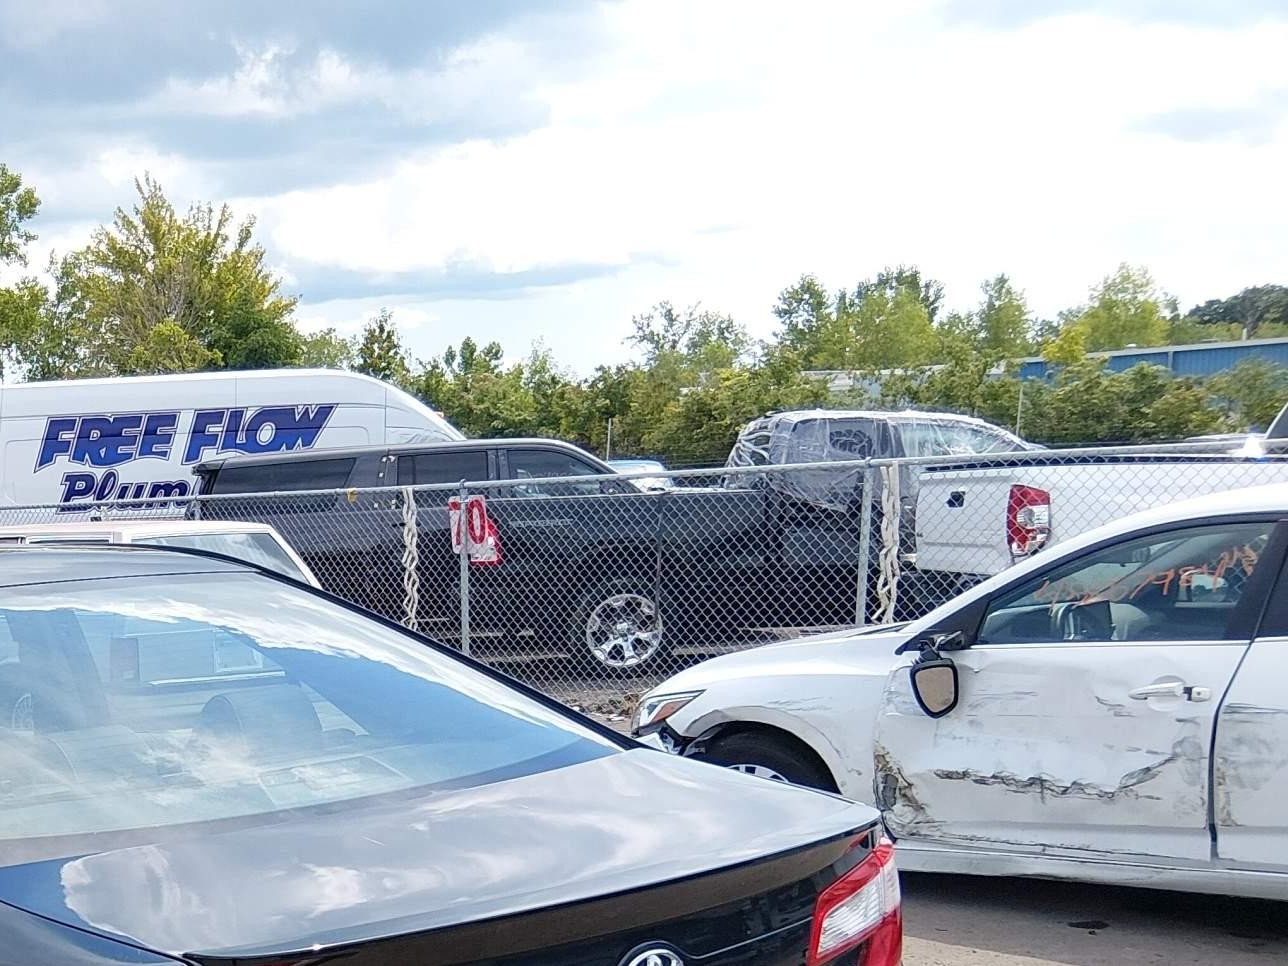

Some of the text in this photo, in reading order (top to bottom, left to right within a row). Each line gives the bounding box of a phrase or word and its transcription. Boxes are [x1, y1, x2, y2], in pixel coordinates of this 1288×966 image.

[34, 403, 339, 474] FREE FLOW
[56, 469, 192, 515] Plum
